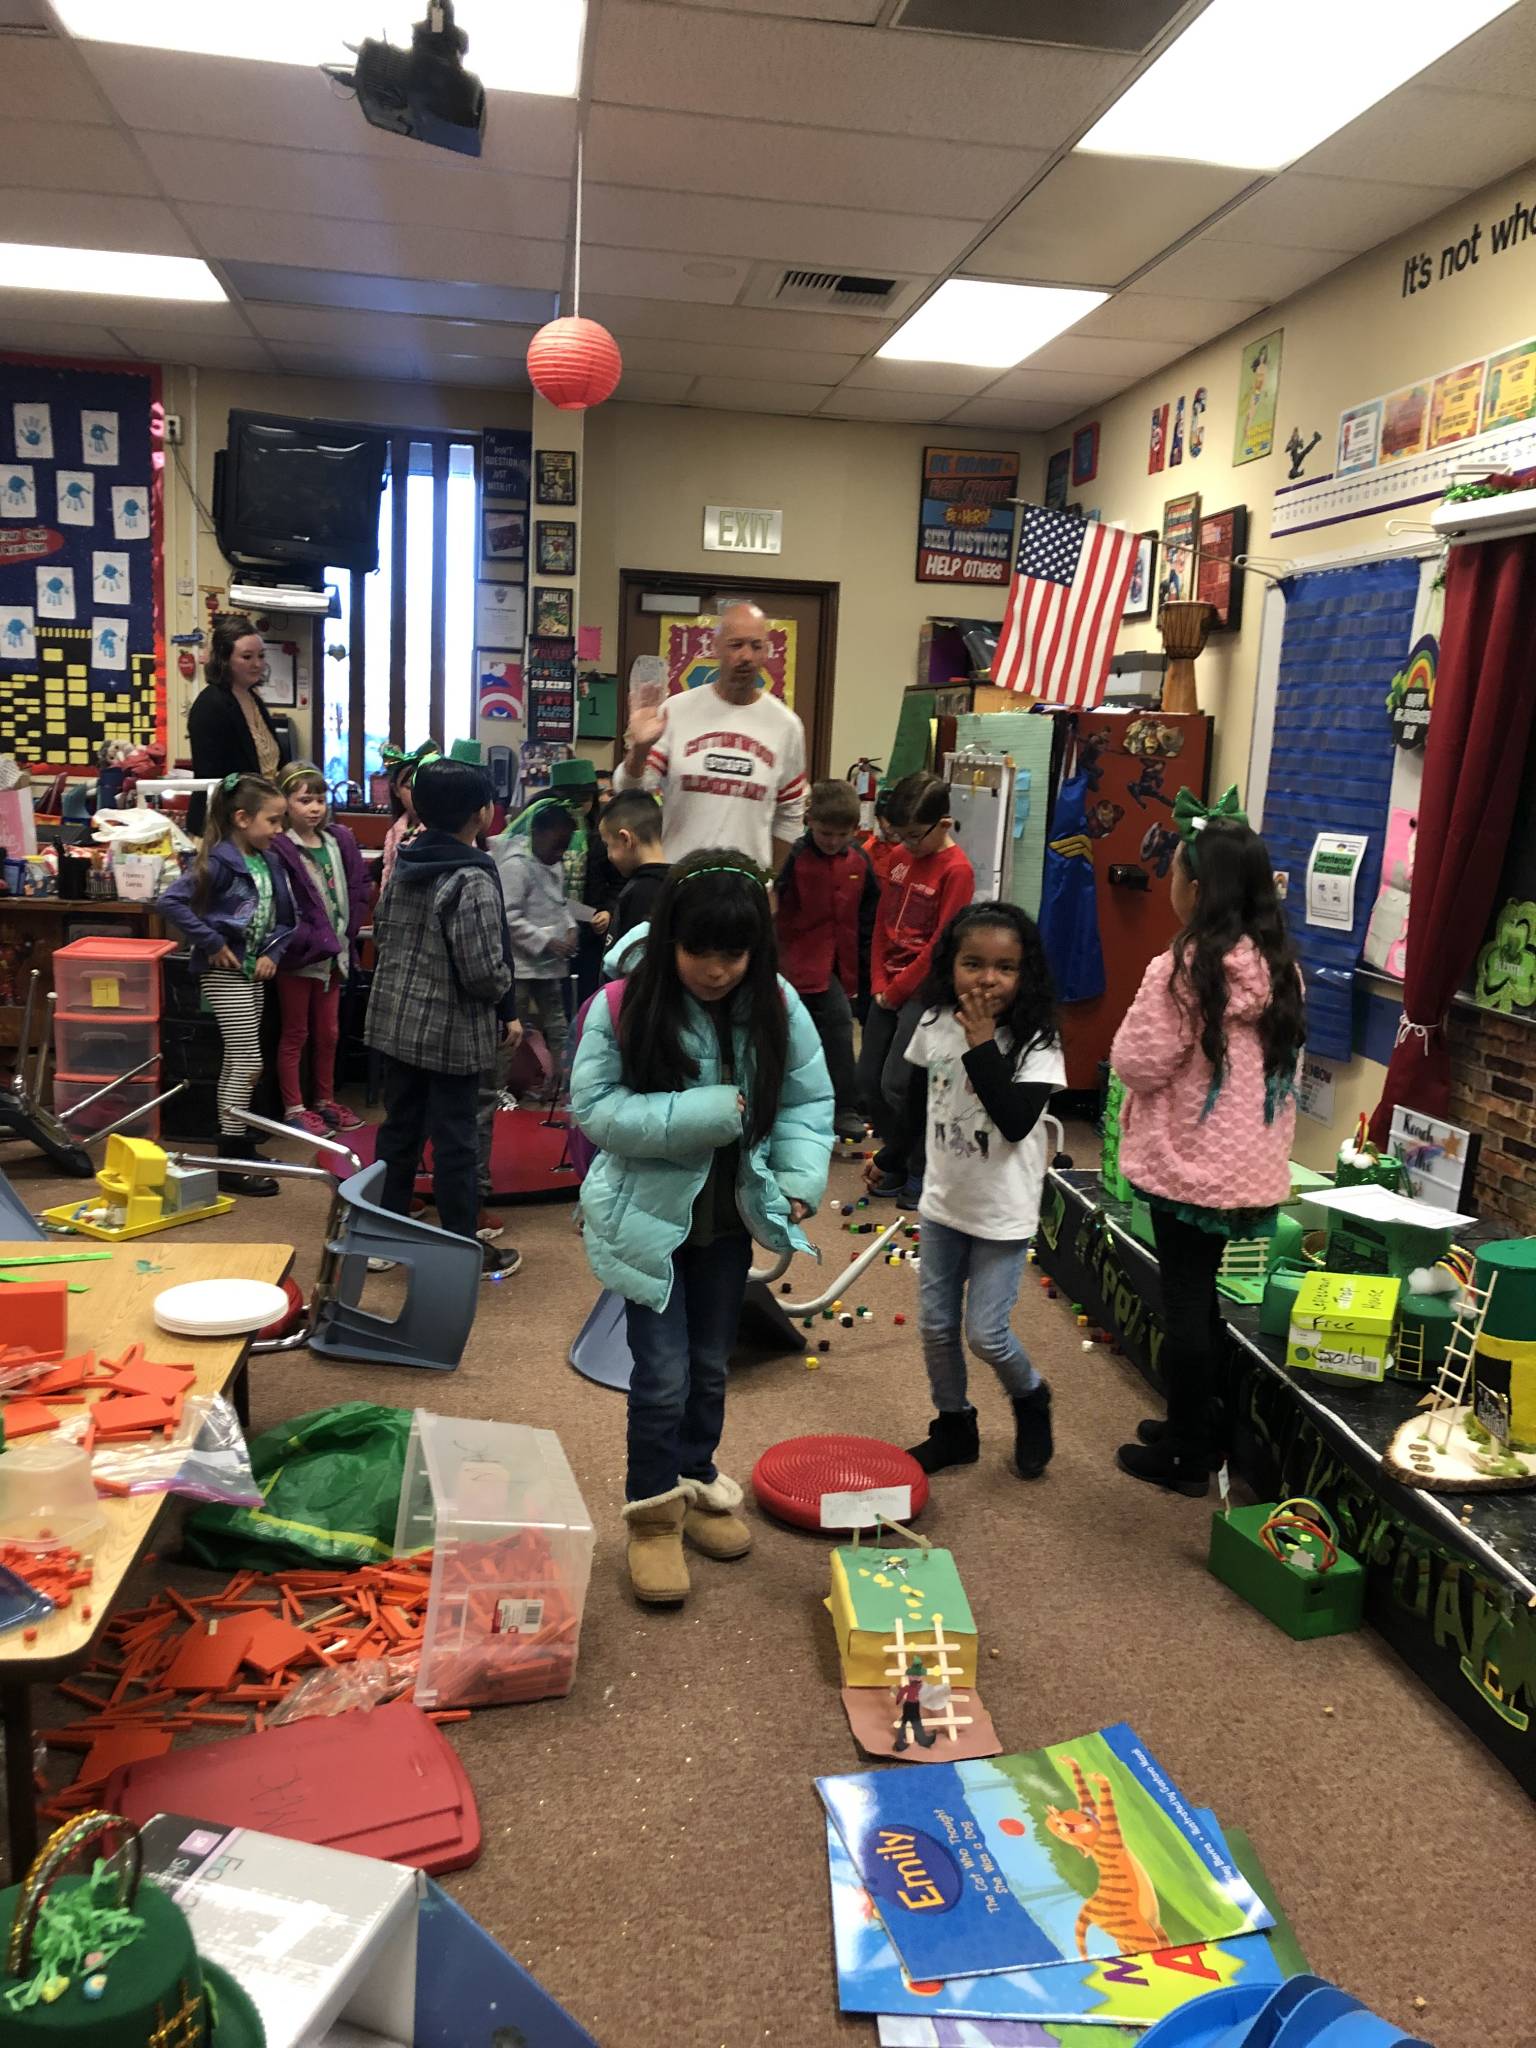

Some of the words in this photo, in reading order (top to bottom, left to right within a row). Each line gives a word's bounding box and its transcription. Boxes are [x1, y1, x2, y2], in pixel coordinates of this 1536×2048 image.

[1402, 252, 1432, 297] It's
[1439, 223, 1482, 280] not
[718, 510, 773, 549] EXIT
[951, 530, 1008, 559] JUSTICE
[925, 554, 961, 577] HELP
[962, 559, 1003, 580] OTHERS
[542, 591, 568, 604] HULK
[588, 697, 600, 716] 1
[1312, 1314, 1356, 1331] Free
[1311, 1345, 1366, 1365] Gold
[1166, 1791, 1177, 1803] by
[933, 1808, 962, 1846] Thought
[1173, 1801, 1201, 1836] Illustrated
[960, 1820, 977, 1840] Dog
[973, 1842, 983, 1850] a
[959, 1848, 975, 1870] Who
[979, 1853, 995, 1873] Was
[876, 1831, 945, 1910] Emily
[969, 1873, 988, 1892] Cat
[992, 1876, 1009, 1894] She
[985, 1894, 1000, 1914] The
